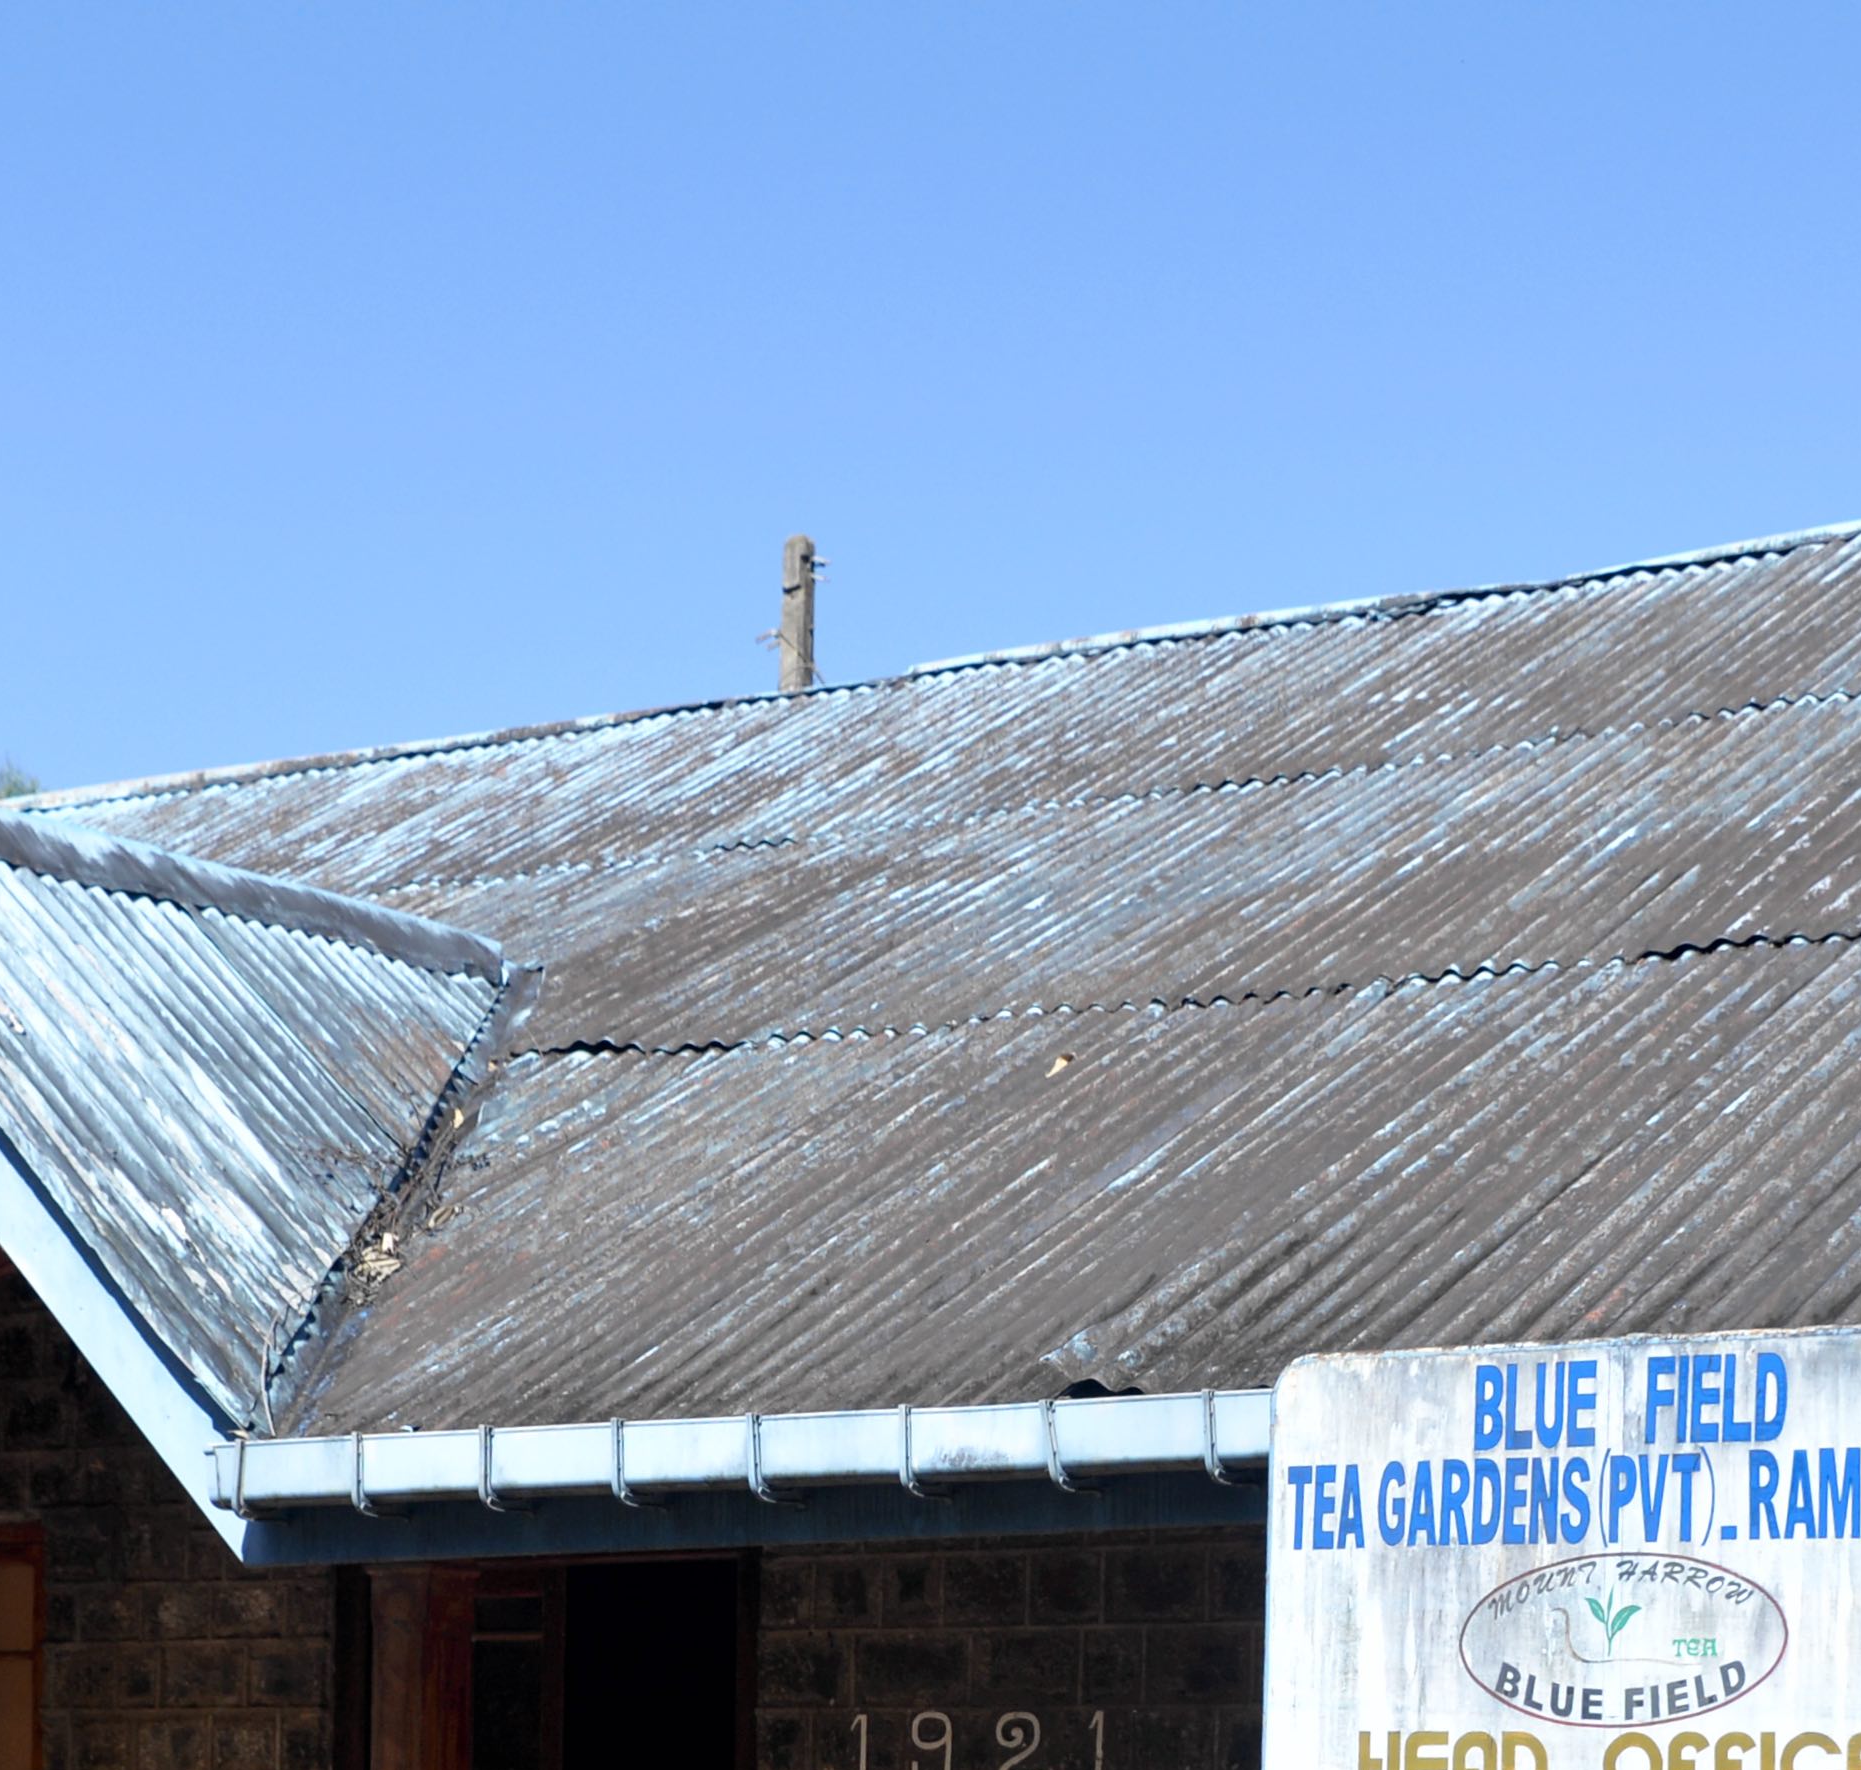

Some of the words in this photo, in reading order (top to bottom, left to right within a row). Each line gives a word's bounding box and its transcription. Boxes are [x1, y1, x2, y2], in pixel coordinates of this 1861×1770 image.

[1474, 1359, 1597, 1451] BLUE
[1645, 1352, 1788, 1444] FIELD
[1288, 1463, 1364, 1550] TEA
[1488, 1561, 1597, 1620] MOUNT
[1616, 1560, 1754, 1604] HARROW
[1673, 1638, 1718, 1657] TEA
[1495, 1662, 1603, 1720] BLUE
[1624, 1660, 1746, 1720] FIELD
